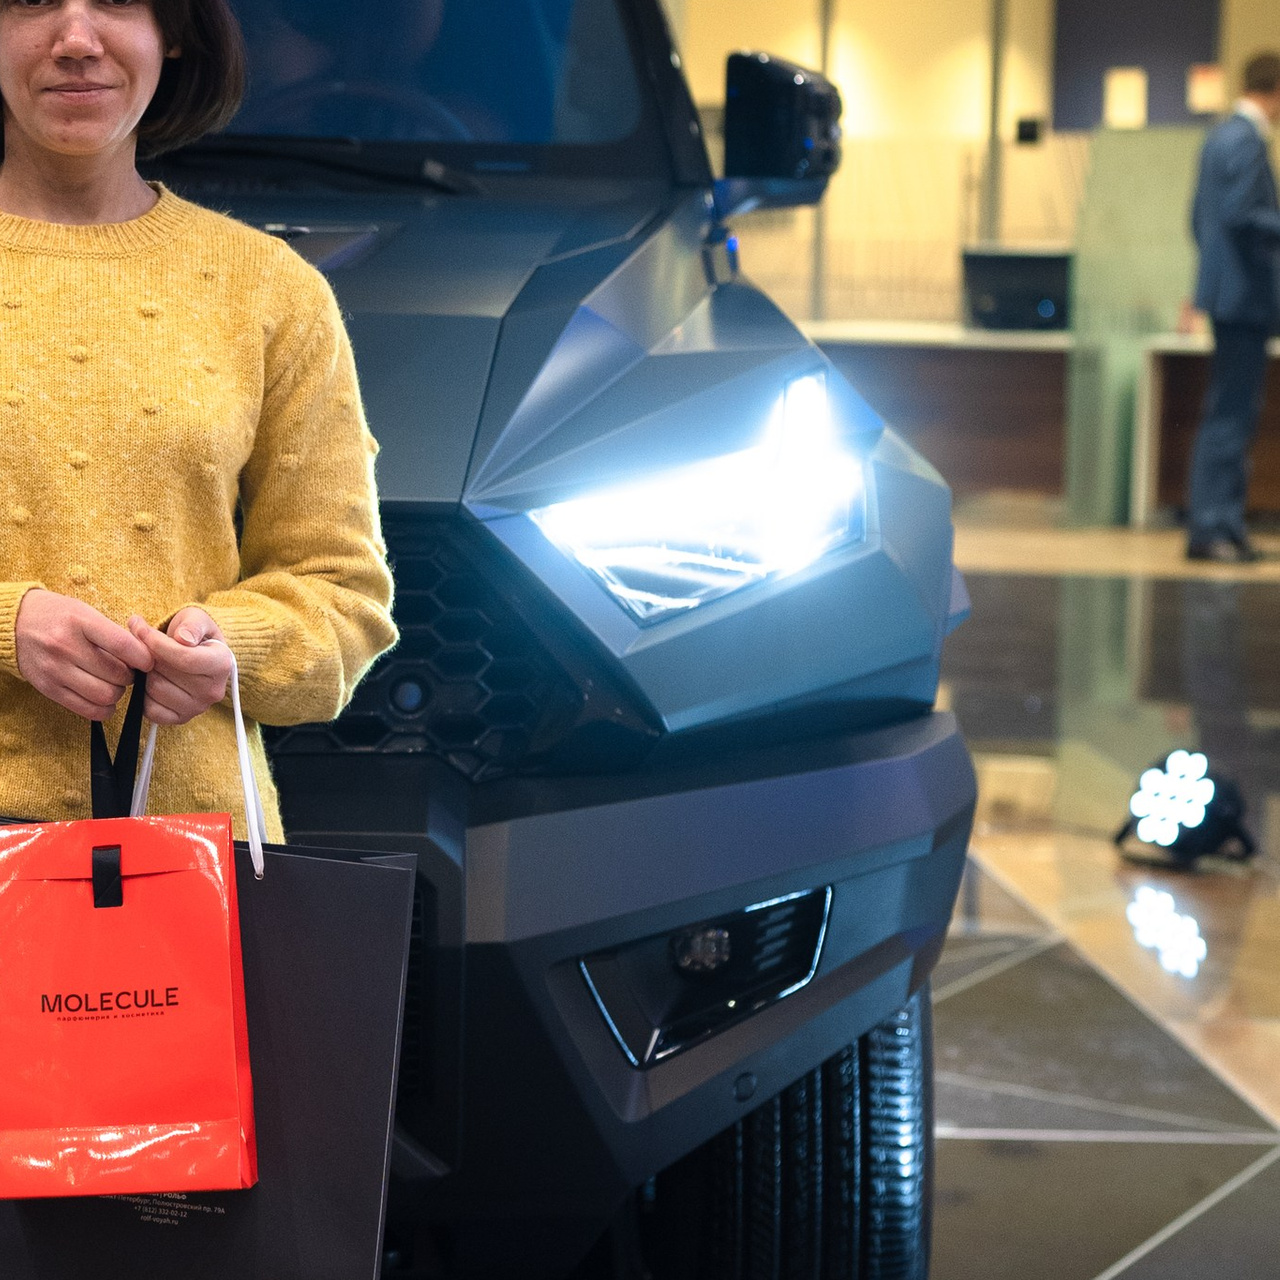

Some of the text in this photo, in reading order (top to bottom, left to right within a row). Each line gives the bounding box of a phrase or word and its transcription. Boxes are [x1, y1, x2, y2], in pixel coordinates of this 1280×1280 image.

[41, 987, 179, 1013] MOLECULE
[121, 1011, 165, 1019] косметика
[158, 1208, 188, 1218] 332-02-12
[140, 1215, 179, 1226] rolf-voyah.ru
